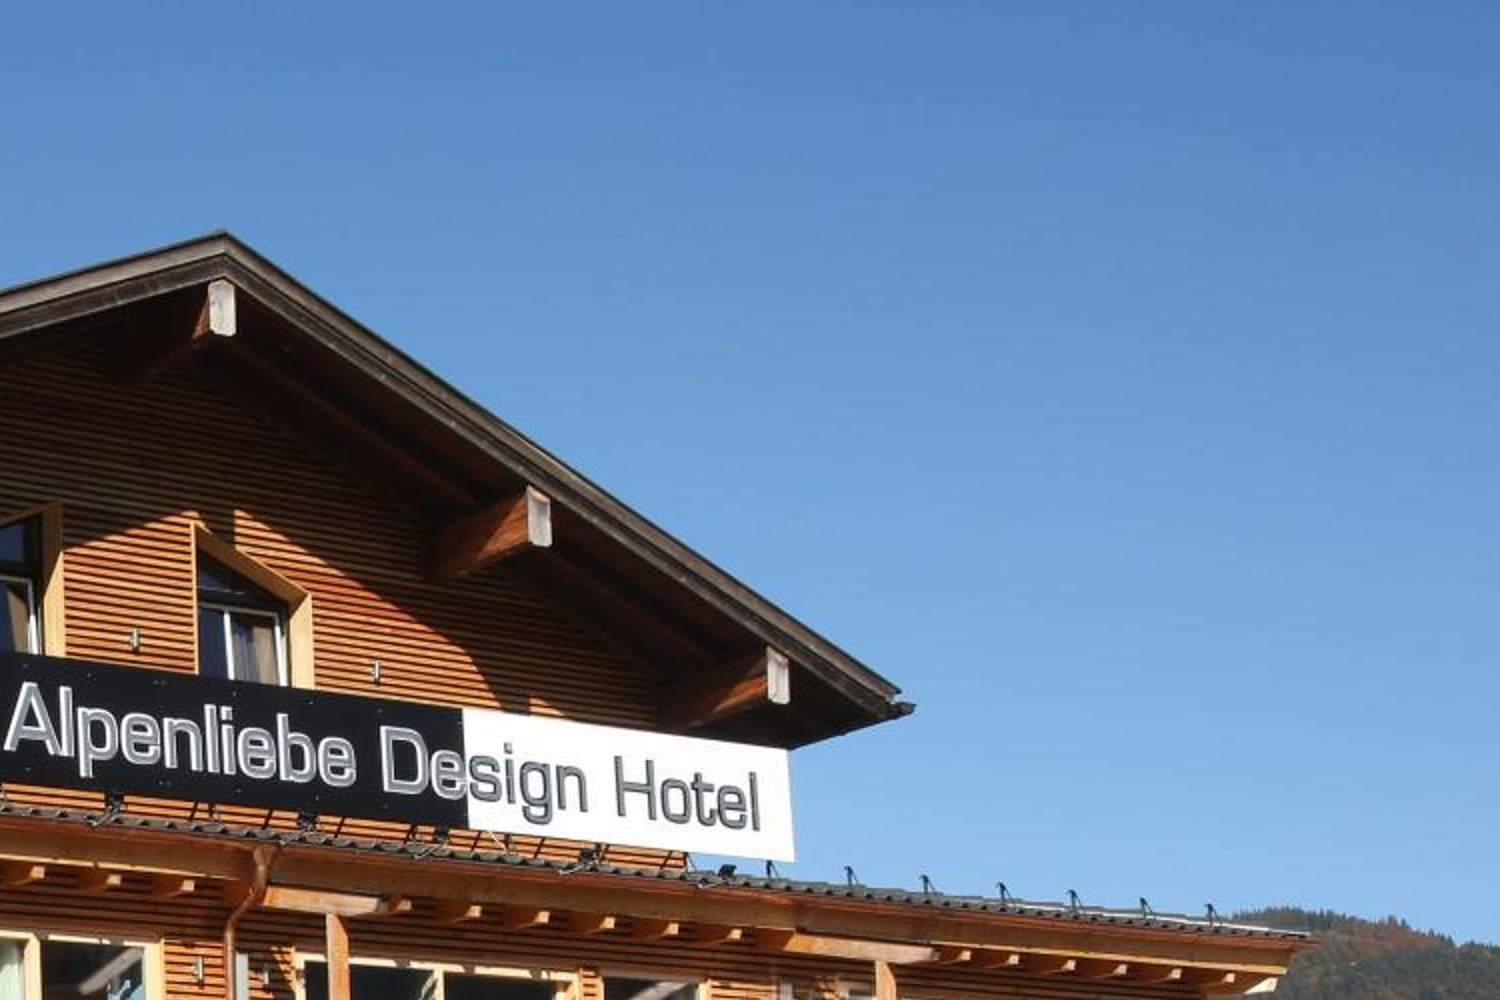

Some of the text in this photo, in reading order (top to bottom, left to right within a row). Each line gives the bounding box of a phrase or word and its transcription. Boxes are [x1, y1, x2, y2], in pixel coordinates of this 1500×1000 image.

[3, 680, 762, 832] Alpenliebe Design Hotel
